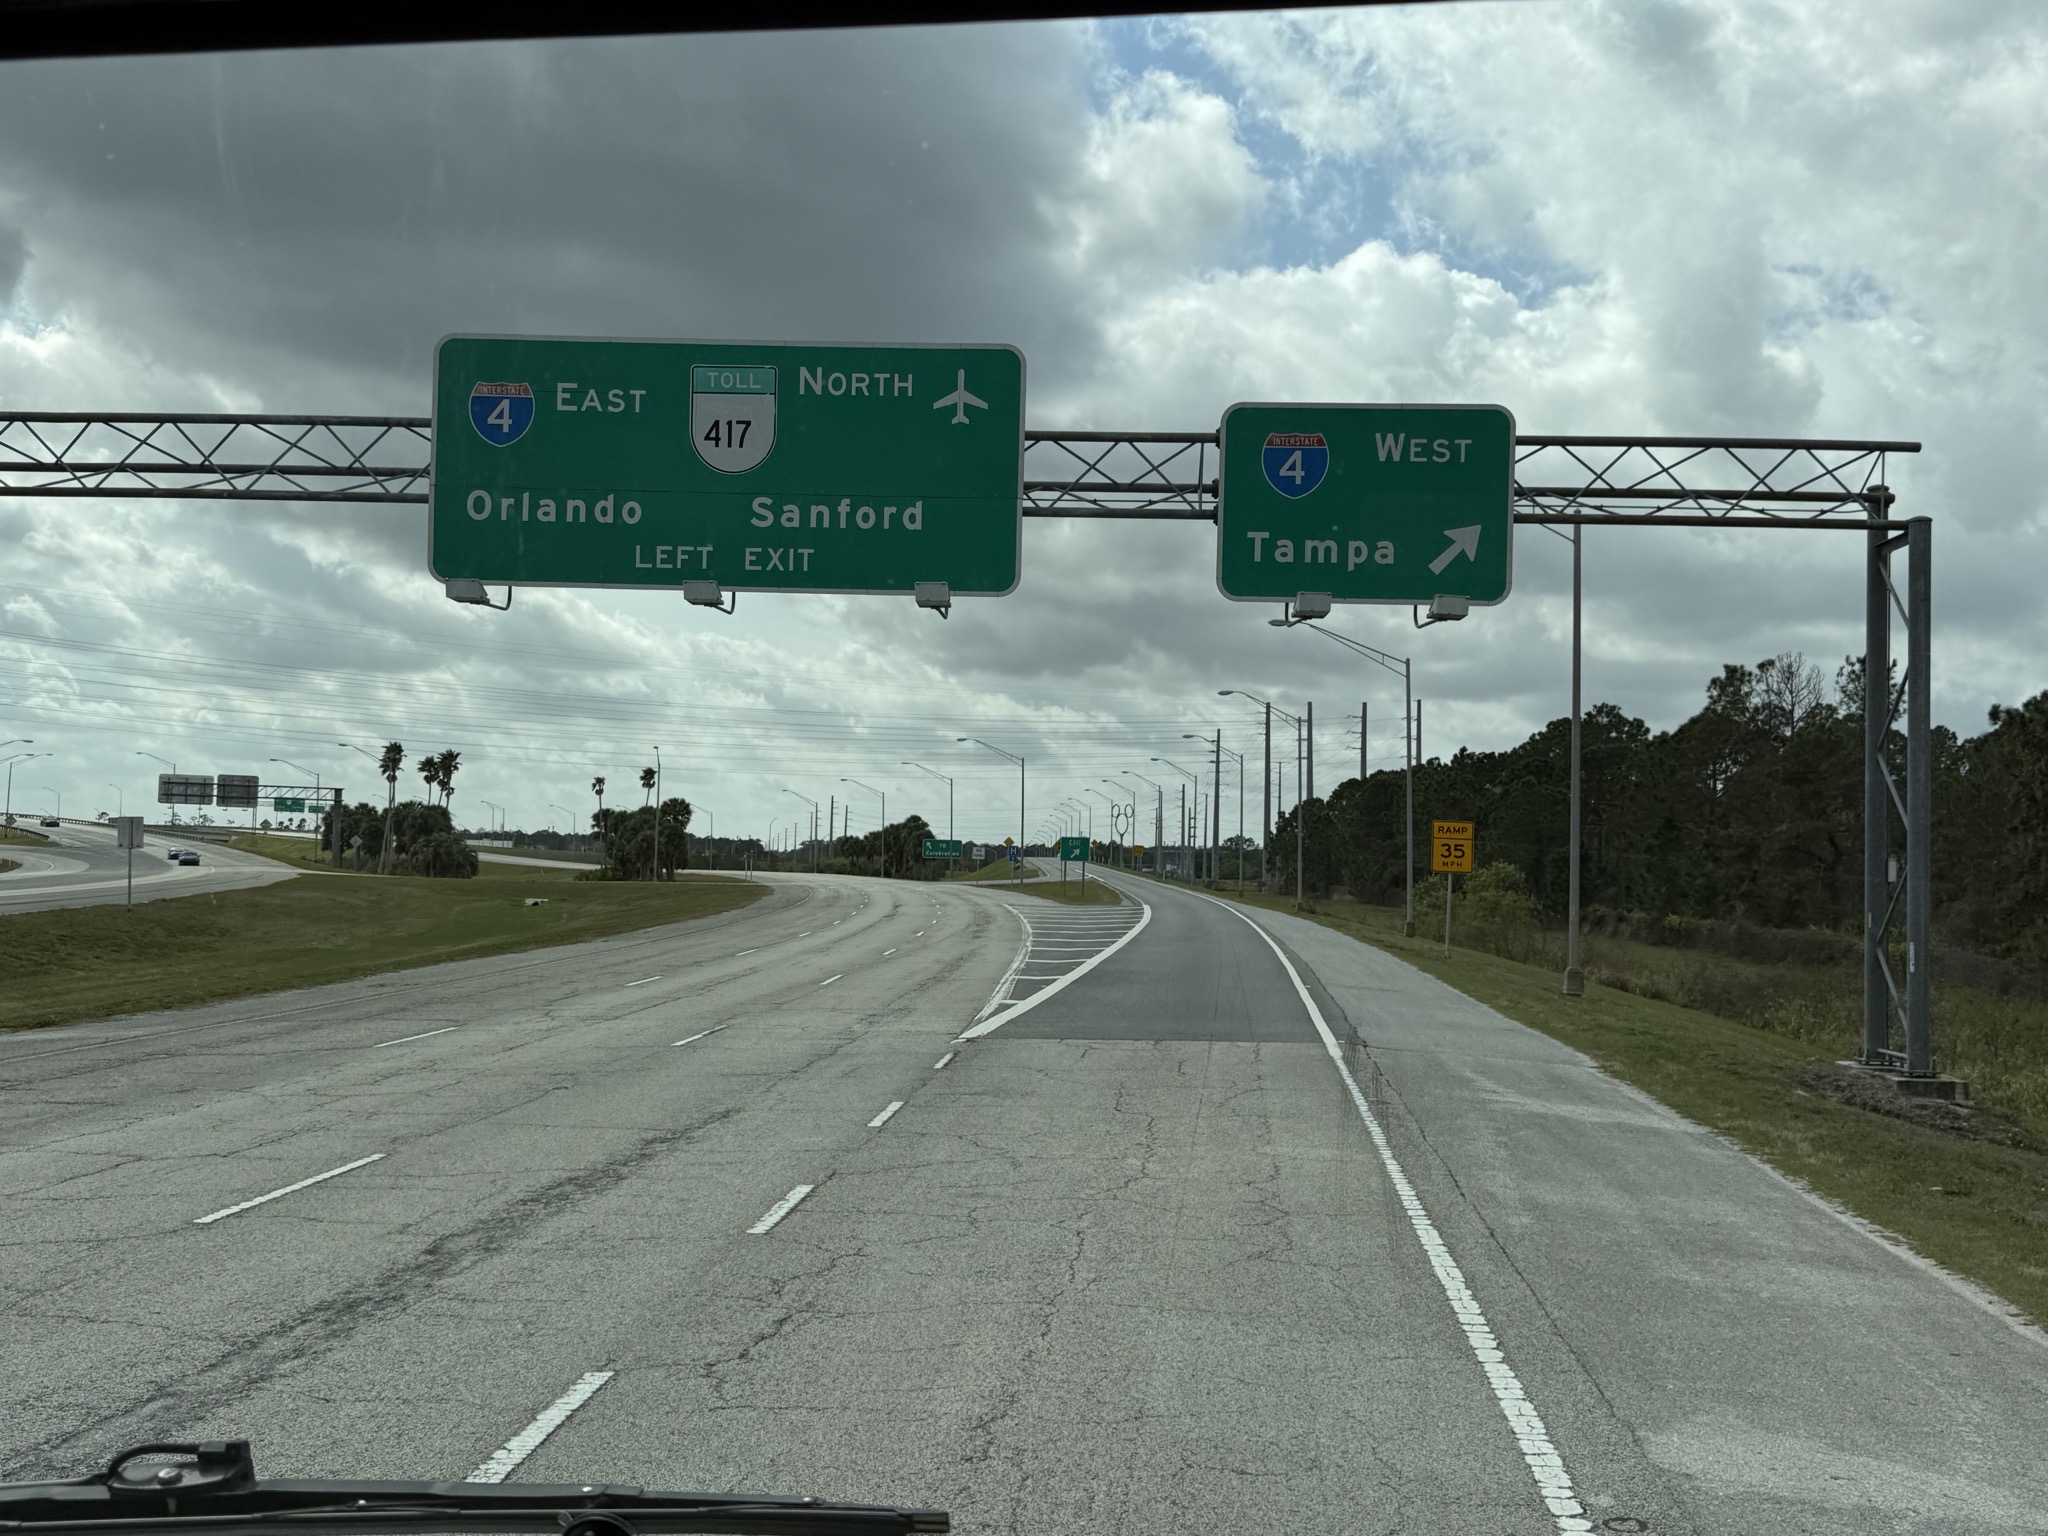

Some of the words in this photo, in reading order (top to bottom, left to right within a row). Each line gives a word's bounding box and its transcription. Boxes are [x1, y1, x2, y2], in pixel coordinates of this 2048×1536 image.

[478, 385, 525, 396] INTERSTATE
[707, 371, 762, 389] TOLL
[799, 366, 913, 397] NORTH
[556, 382, 647, 413] EAST
[487, 398, 513, 433] 4
[703, 419, 752, 448] 417
[1272, 437, 1319, 447] INTERSTATE
[1375, 432, 1472, 463] WEST
[1279, 450, 1305, 485] 4
[466, 489, 643, 525] Orlando
[750, 496, 923, 530] Sanford
[634, 544, 714, 570] LEFT
[744, 546, 815, 572] EXIT
[1247, 531, 1395, 572] Tampa
[1438, 825, 1468, 835] RAMP
[1440, 843, 1465, 859] 35
[1442, 860, 1463, 868] MPH
